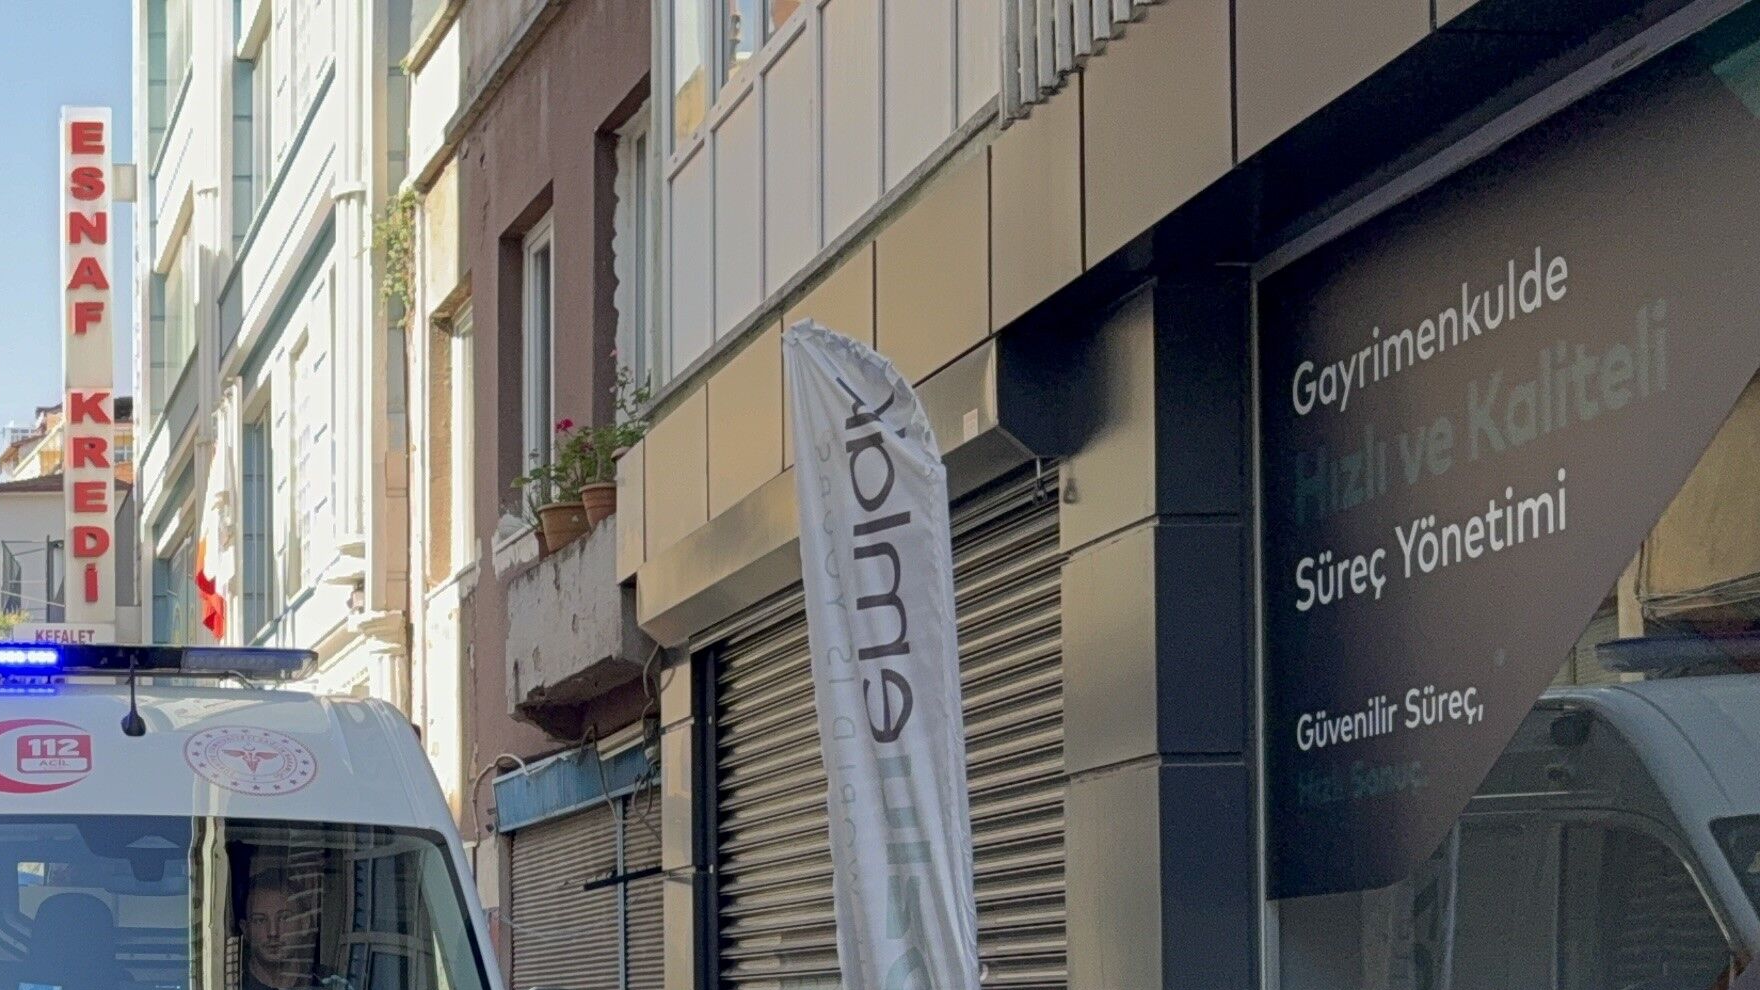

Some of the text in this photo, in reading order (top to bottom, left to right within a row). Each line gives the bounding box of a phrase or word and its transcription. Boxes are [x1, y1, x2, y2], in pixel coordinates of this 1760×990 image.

[67, 120, 111, 604] ESNAF KREDİ
[1292, 245, 1569, 417] Gayrimenkulde
[1397, 415, 1455, 487] ve
[1466, 297, 1671, 463] Kaliteli
[1295, 468, 1567, 613] Süreç Yönetimi
[28, 738, 80, 757] 112
[1297, 683, 1484, 752] Güvenilir Süreç,
